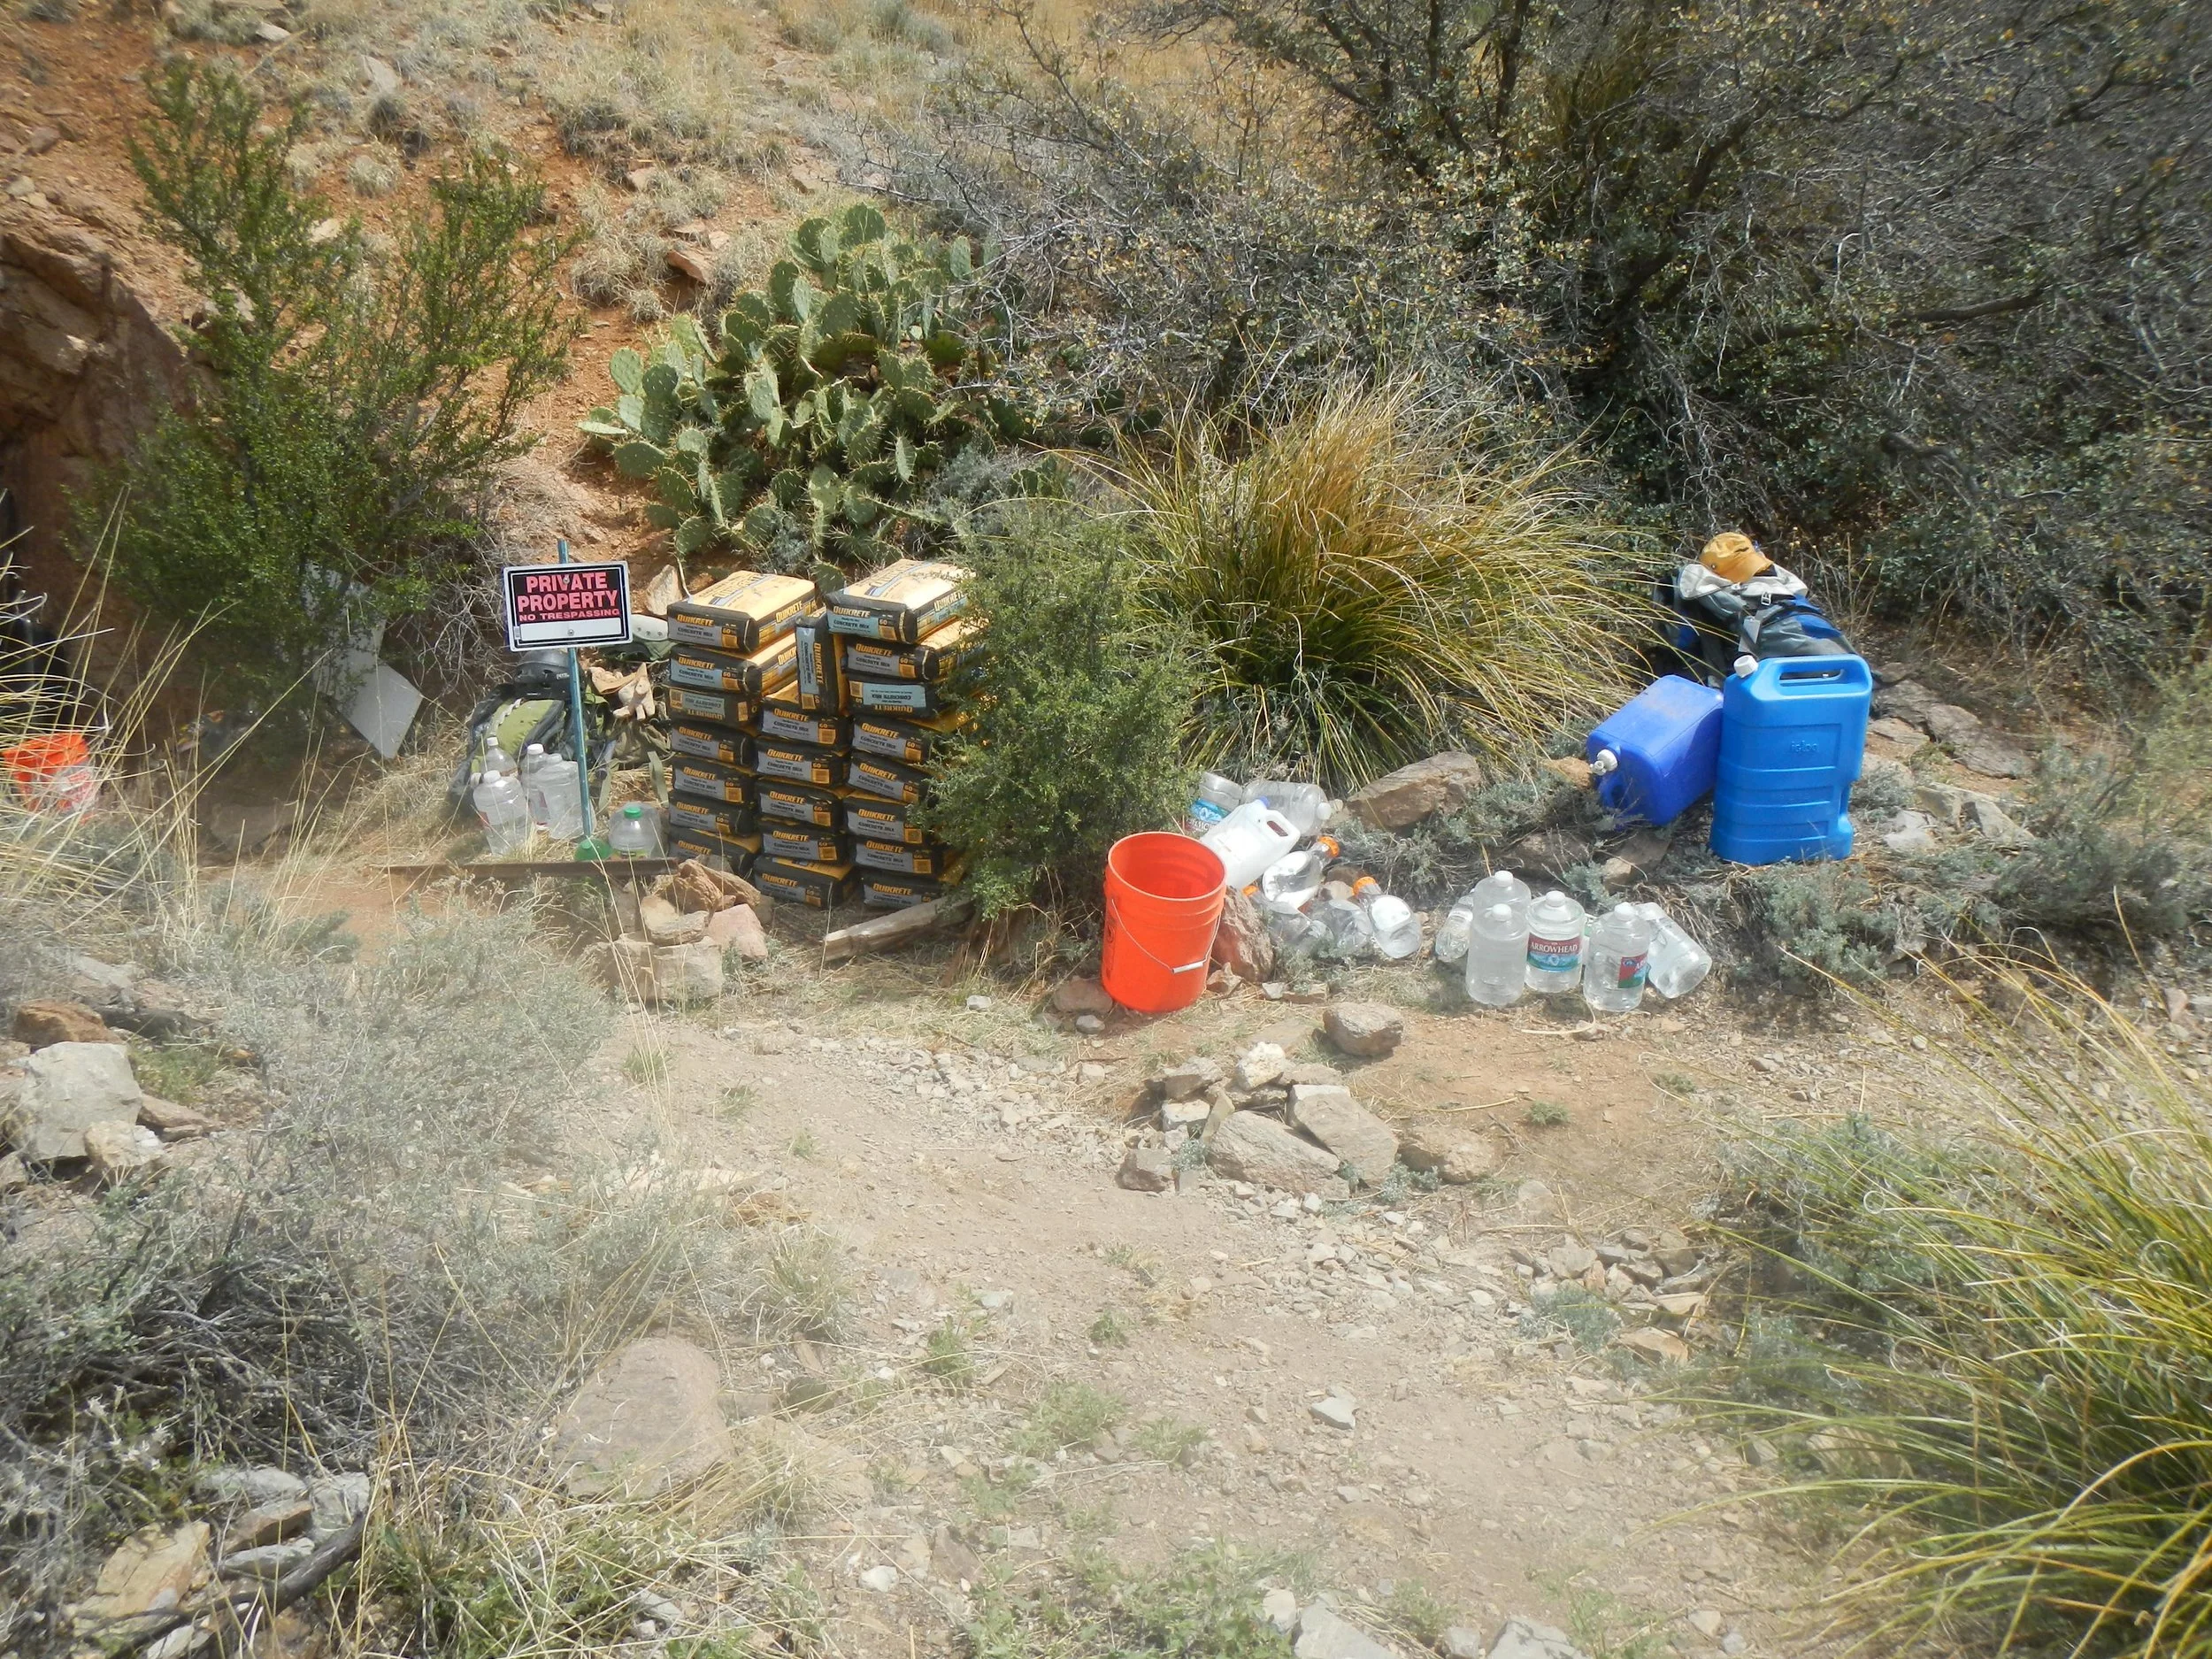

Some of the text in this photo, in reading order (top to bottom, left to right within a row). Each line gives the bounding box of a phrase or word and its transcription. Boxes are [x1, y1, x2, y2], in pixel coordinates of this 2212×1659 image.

[526, 572, 608, 593] PRIVATE
[517, 590, 618, 612] PROPERTY
[519, 608, 619, 622] NO TRESPASSING
[776, 601, 803, 623] QUIKRETE
[833, 606, 871, 618] QUIKRETE
[677, 614, 714, 626] QUIKRETE
[856, 643, 893, 657] QUIKRETE
[678, 657, 715, 670] QUIKRETE
[814, 642, 824, 684] QUIKRETE
[773, 708, 810, 722] QUIKRETE
[679, 726, 713, 741] QUIKRETE
[861, 723, 899, 739] QUIKRETE
[766, 749, 803, 762] QUIKRETE
[683, 767, 717, 780] QUIKRETE
[859, 763, 897, 780] QUIKRETE
[769, 790, 806, 804] QUIKRETE
[676, 802, 709, 814] QUIKRETE
[858, 809, 895, 821] QUIKRETE
[772, 830, 810, 841] QUIKRETE
[678, 840, 711, 855] QUIKRETE
[865, 841, 903, 854] QUIKRETE
[762, 873, 797, 887] QUIKRETE
[872, 883, 912, 895] QUIKRETE
[1530, 942, 1578, 953] ARROWHEAD
